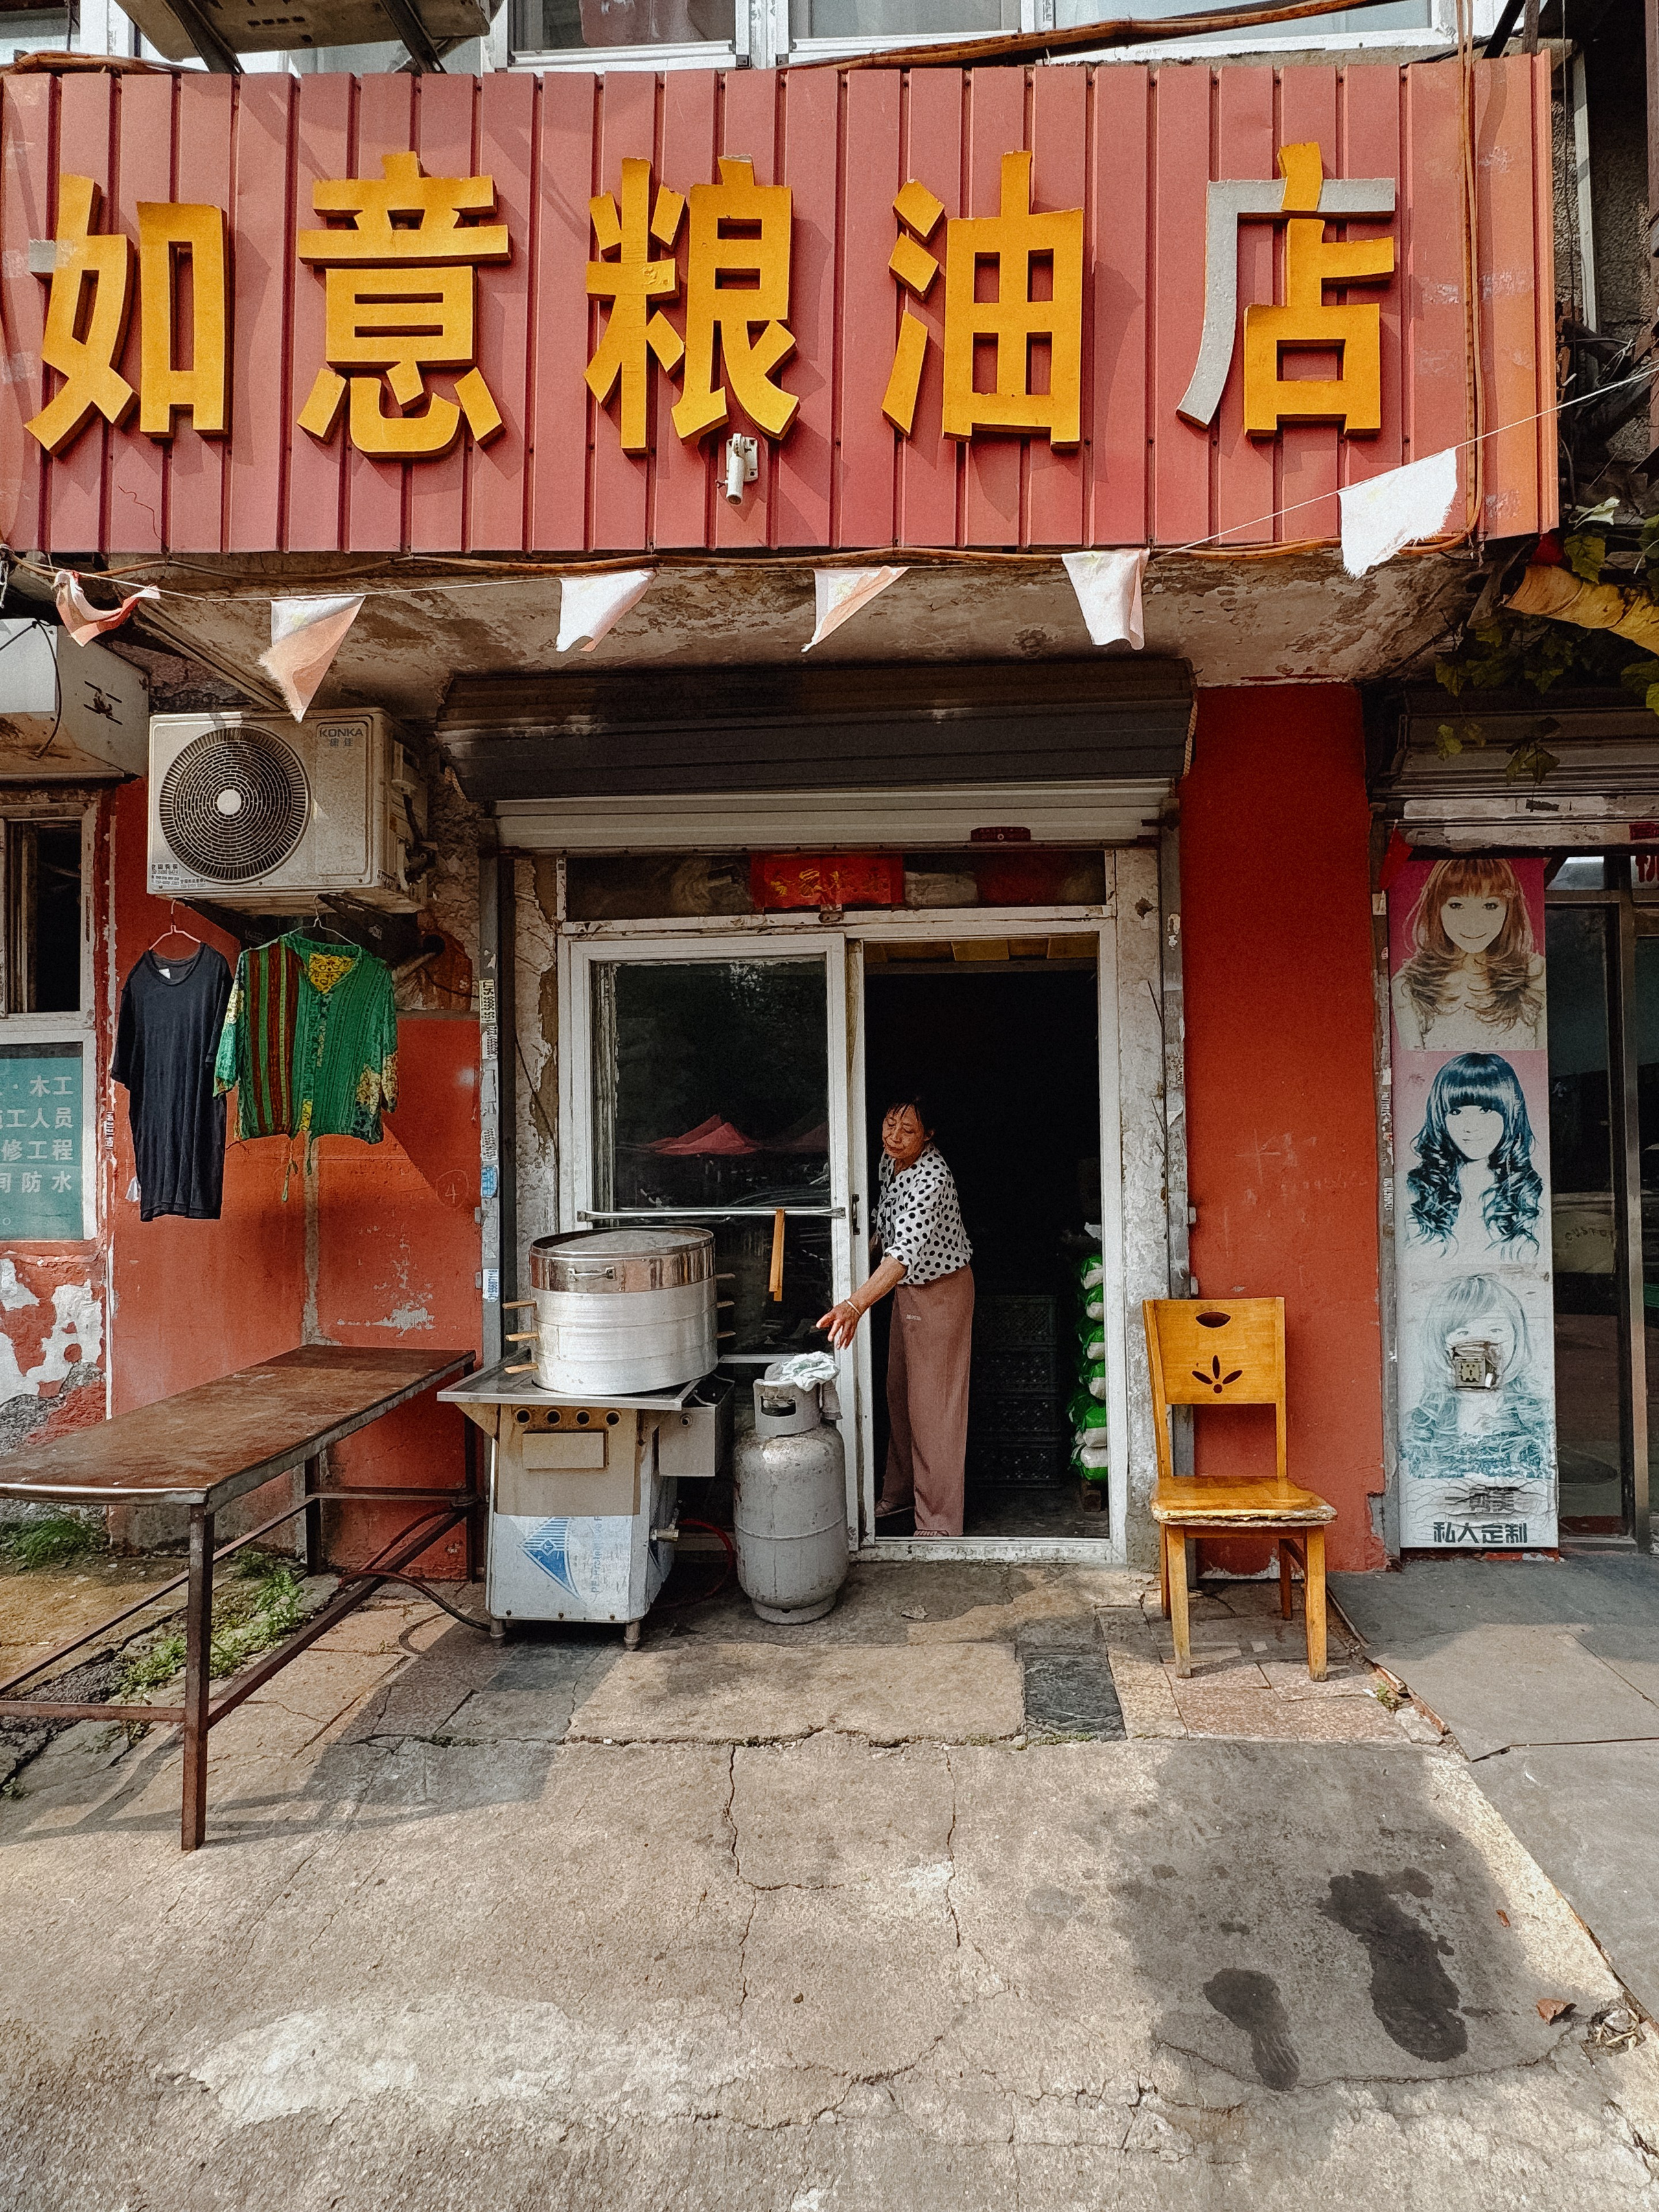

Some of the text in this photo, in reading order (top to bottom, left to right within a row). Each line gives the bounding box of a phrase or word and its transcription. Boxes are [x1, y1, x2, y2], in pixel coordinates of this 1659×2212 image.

[24, 141, 1396, 459] 如意粮油店
[319, 728, 363, 737] KONKA
[0, 1107, 74, 1128] 工人员
[1, 1139, 74, 1161] 修工程
[1433, 1522, 1528, 1544] 私人定制
[591, 1580, 600, 1593] PE
